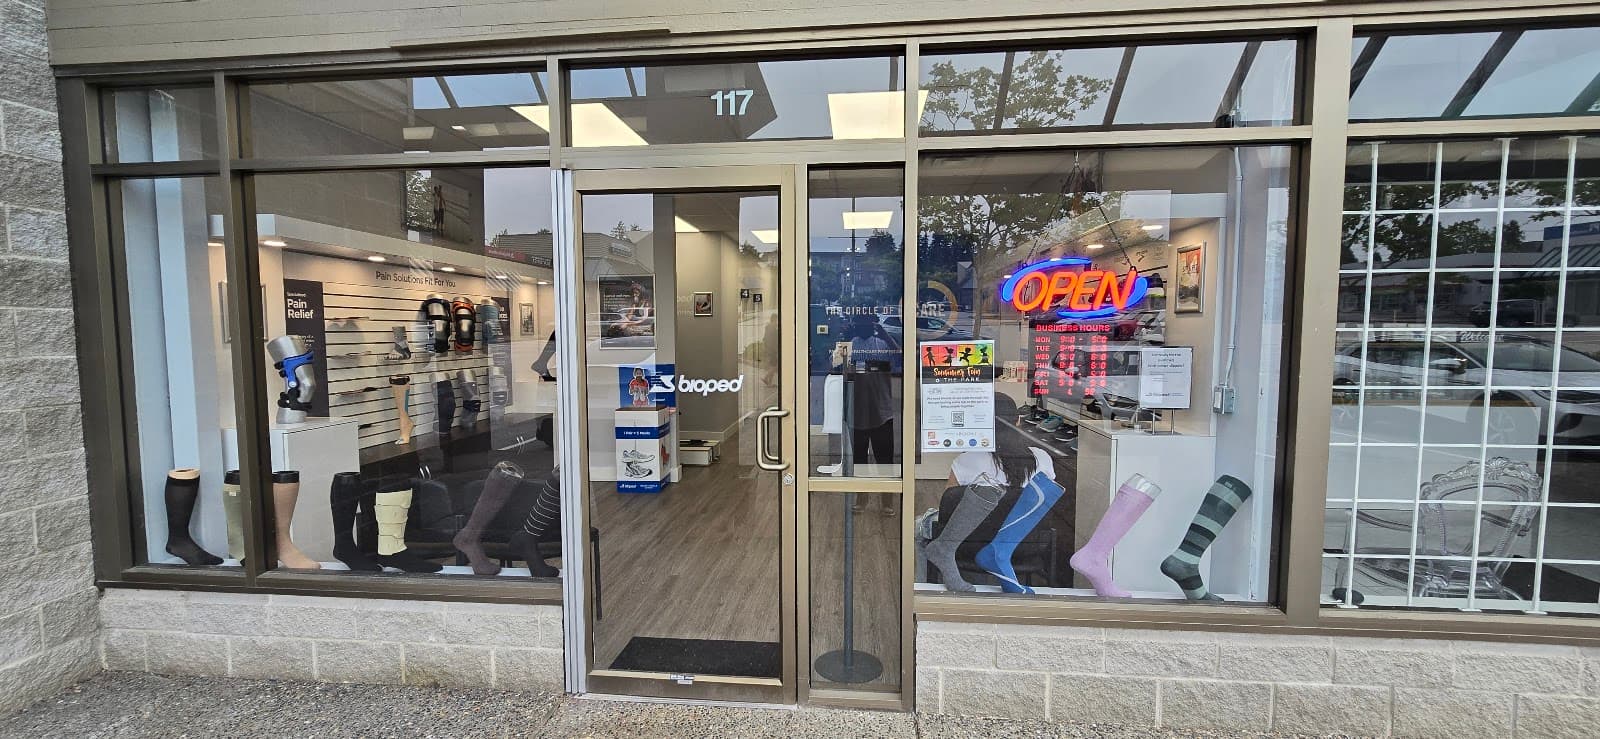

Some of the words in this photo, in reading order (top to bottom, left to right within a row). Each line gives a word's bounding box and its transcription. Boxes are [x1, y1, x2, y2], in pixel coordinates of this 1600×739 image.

[710, 89, 754, 116] 117
[375, 270, 391, 281] Pain
[393, 272, 423, 285] Solutions
[424, 276, 433, 286] Fit
[434, 277, 444, 287] For
[445, 279, 456, 288] You
[1012, 270, 1138, 313] OPEN
[287, 299, 307, 309] Pain
[883, 306, 895, 315] OF
[916, 303, 946, 317] ARE
[287, 309, 314, 319] Relief
[1035, 324, 1079, 332] BUSINESS
[1079, 324, 1111, 332] HOURS
[933, 368, 965, 377] Summer
[967, 367, 981, 376] Fun
[678, 374, 744, 396] bioped
